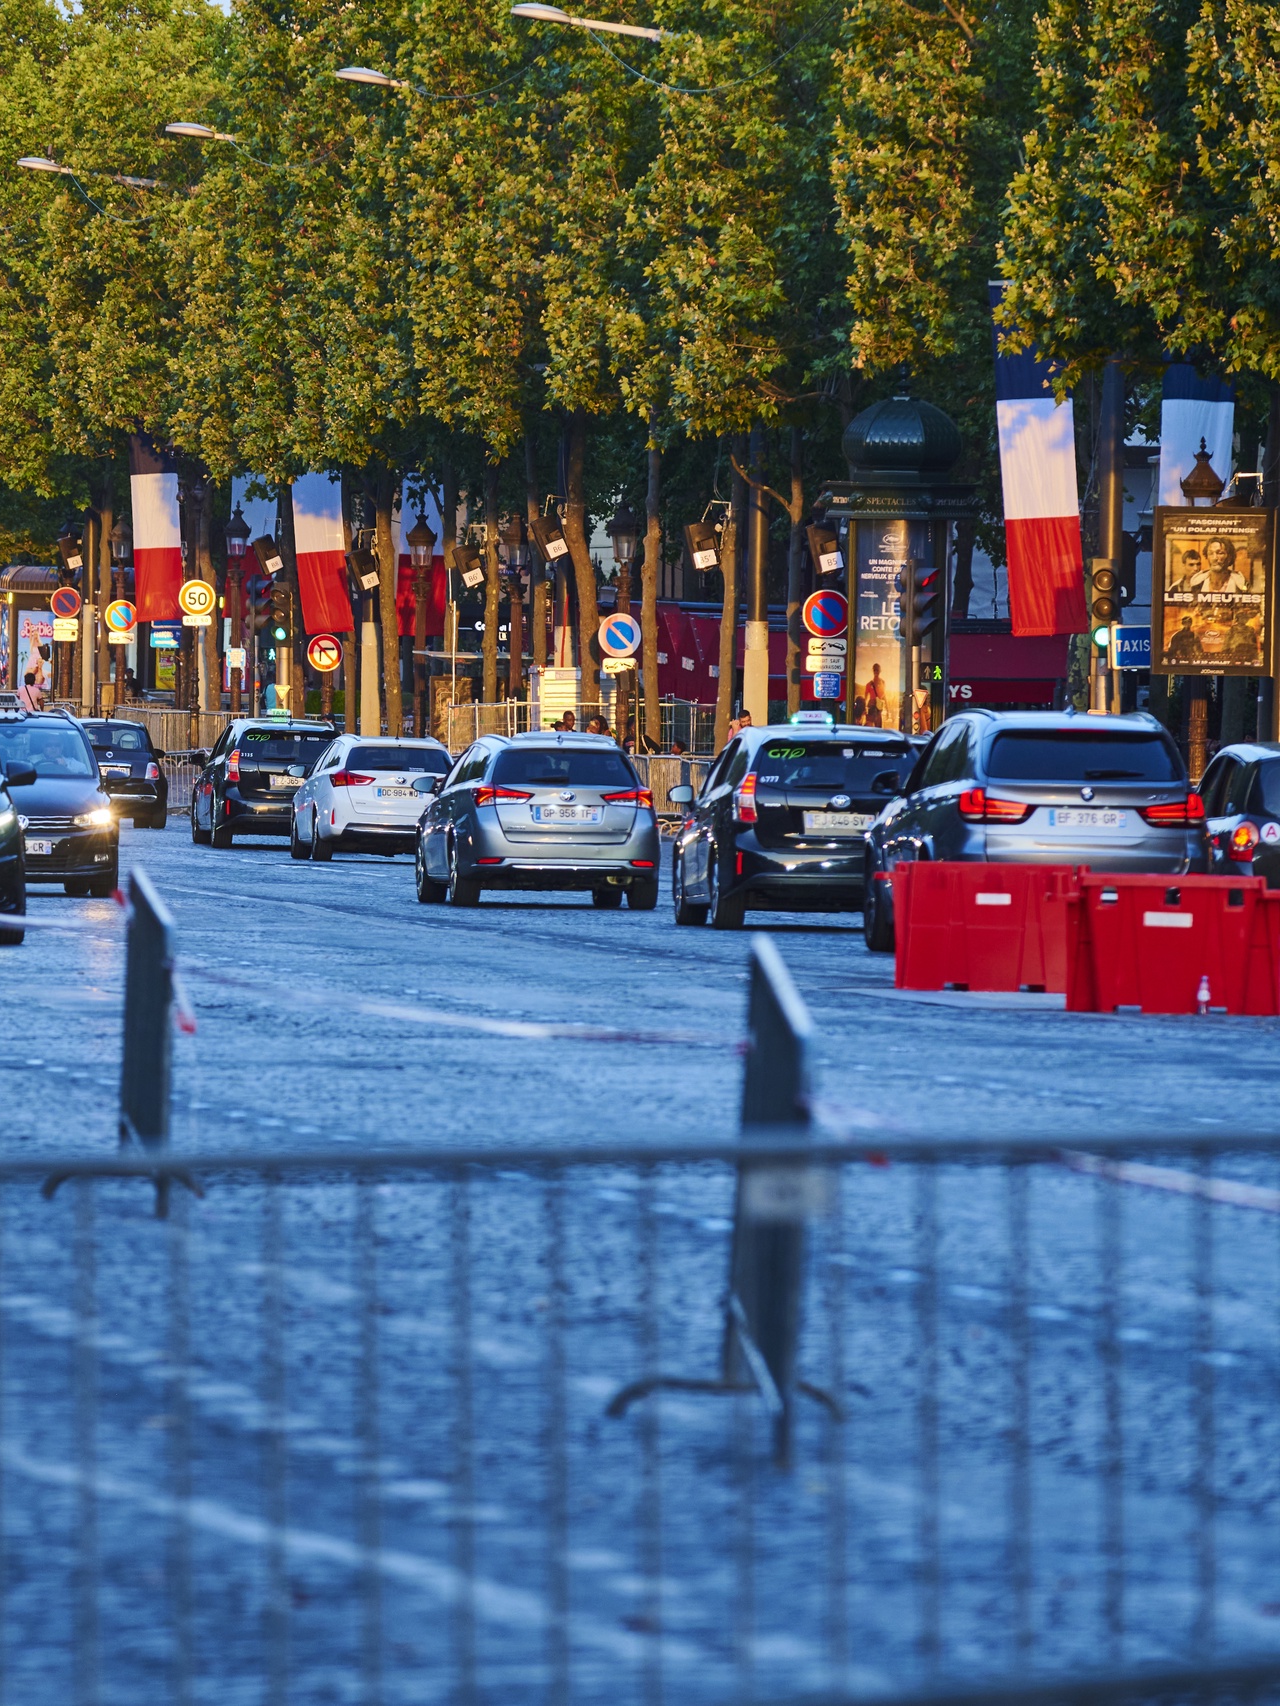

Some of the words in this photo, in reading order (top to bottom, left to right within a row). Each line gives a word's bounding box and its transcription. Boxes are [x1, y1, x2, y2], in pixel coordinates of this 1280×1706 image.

[866, 497, 917, 506] SPECTACLES
[552, 545, 563, 553] B6
[826, 558, 838, 567] B5
[366, 576, 375, 585] B7
[187, 592, 208, 606] 50
[1163, 592, 1194, 602] LES
[1197, 593, 1261, 604] MEUTES
[882, 602, 901, 616] LE
[20, 618, 54, 638] Barbie
[861, 616, 901, 631] RETO
[1116, 639, 1151, 653] TAXIS
[759, 775, 780, 783] 6777
[1265, 825, 1277, 838] A
